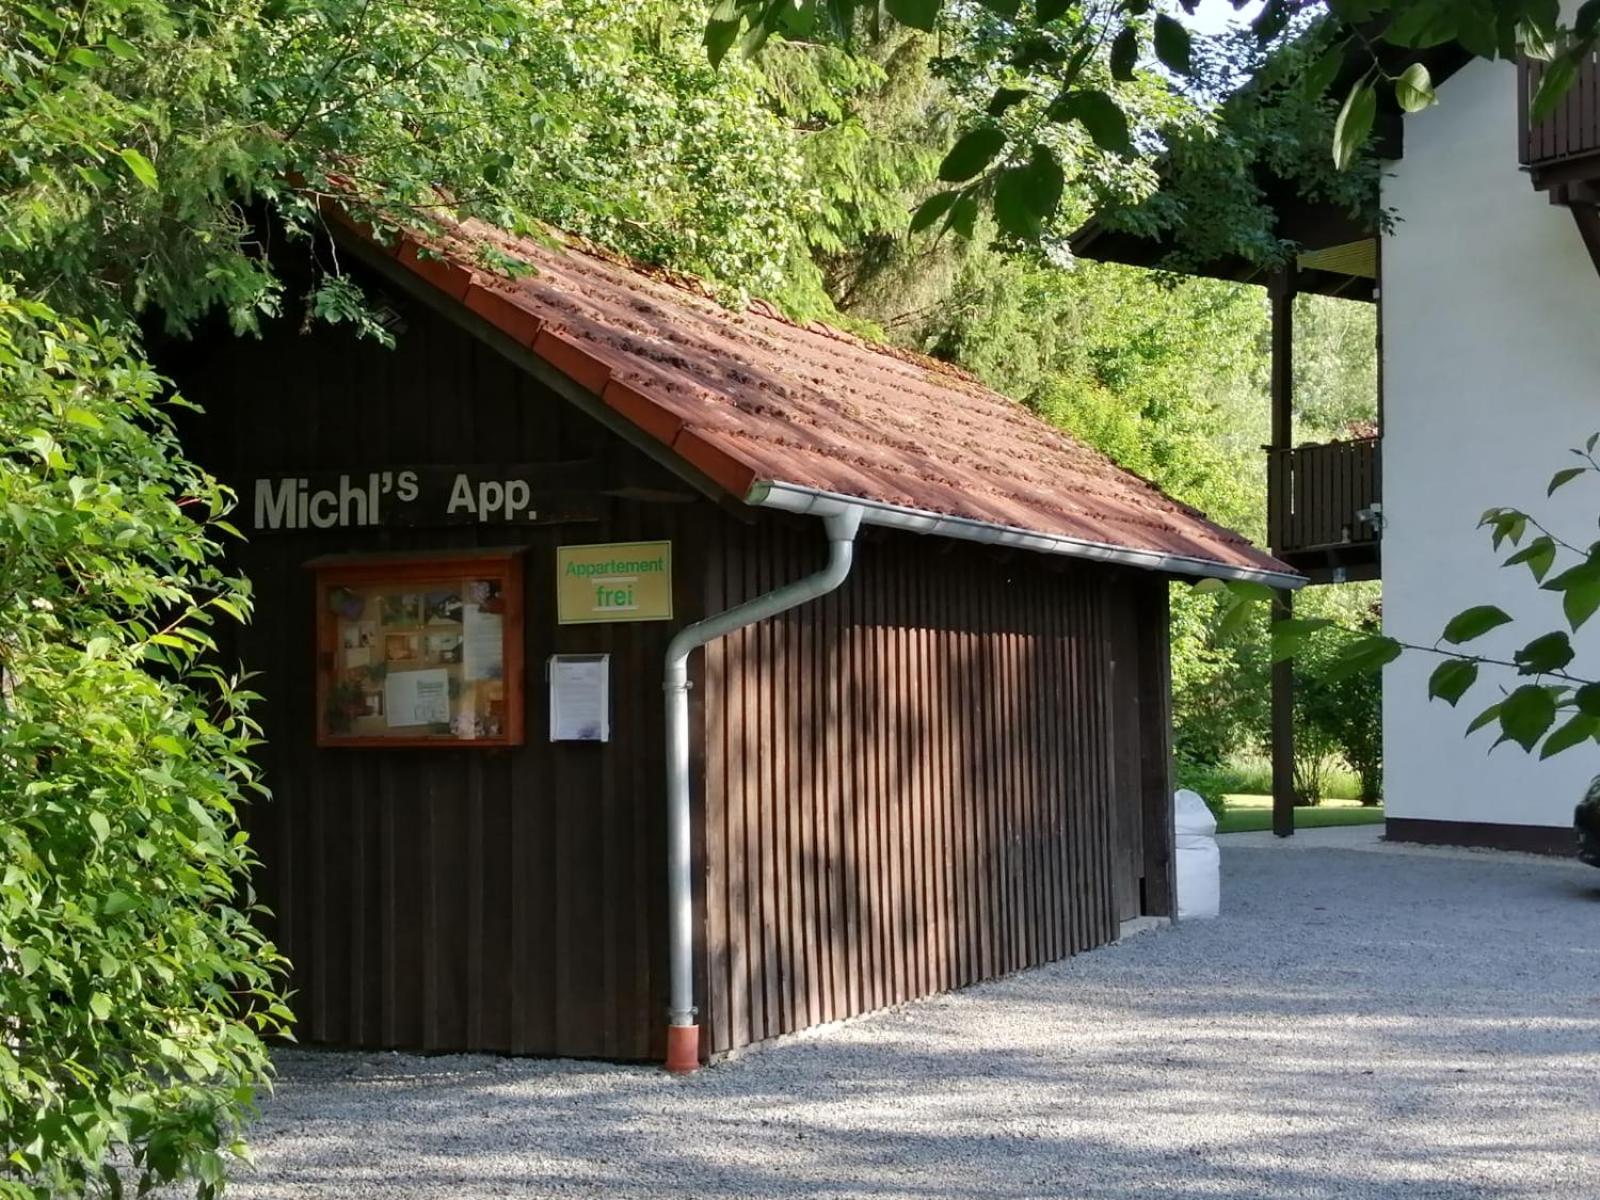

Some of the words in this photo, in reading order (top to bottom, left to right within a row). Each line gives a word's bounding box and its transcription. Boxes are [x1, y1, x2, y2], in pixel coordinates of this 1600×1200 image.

[254, 470, 419, 530] Michl's
[446, 473, 537, 522] App.
[565, 557, 664, 577] Appartement
[596, 584, 633, 607] frei
